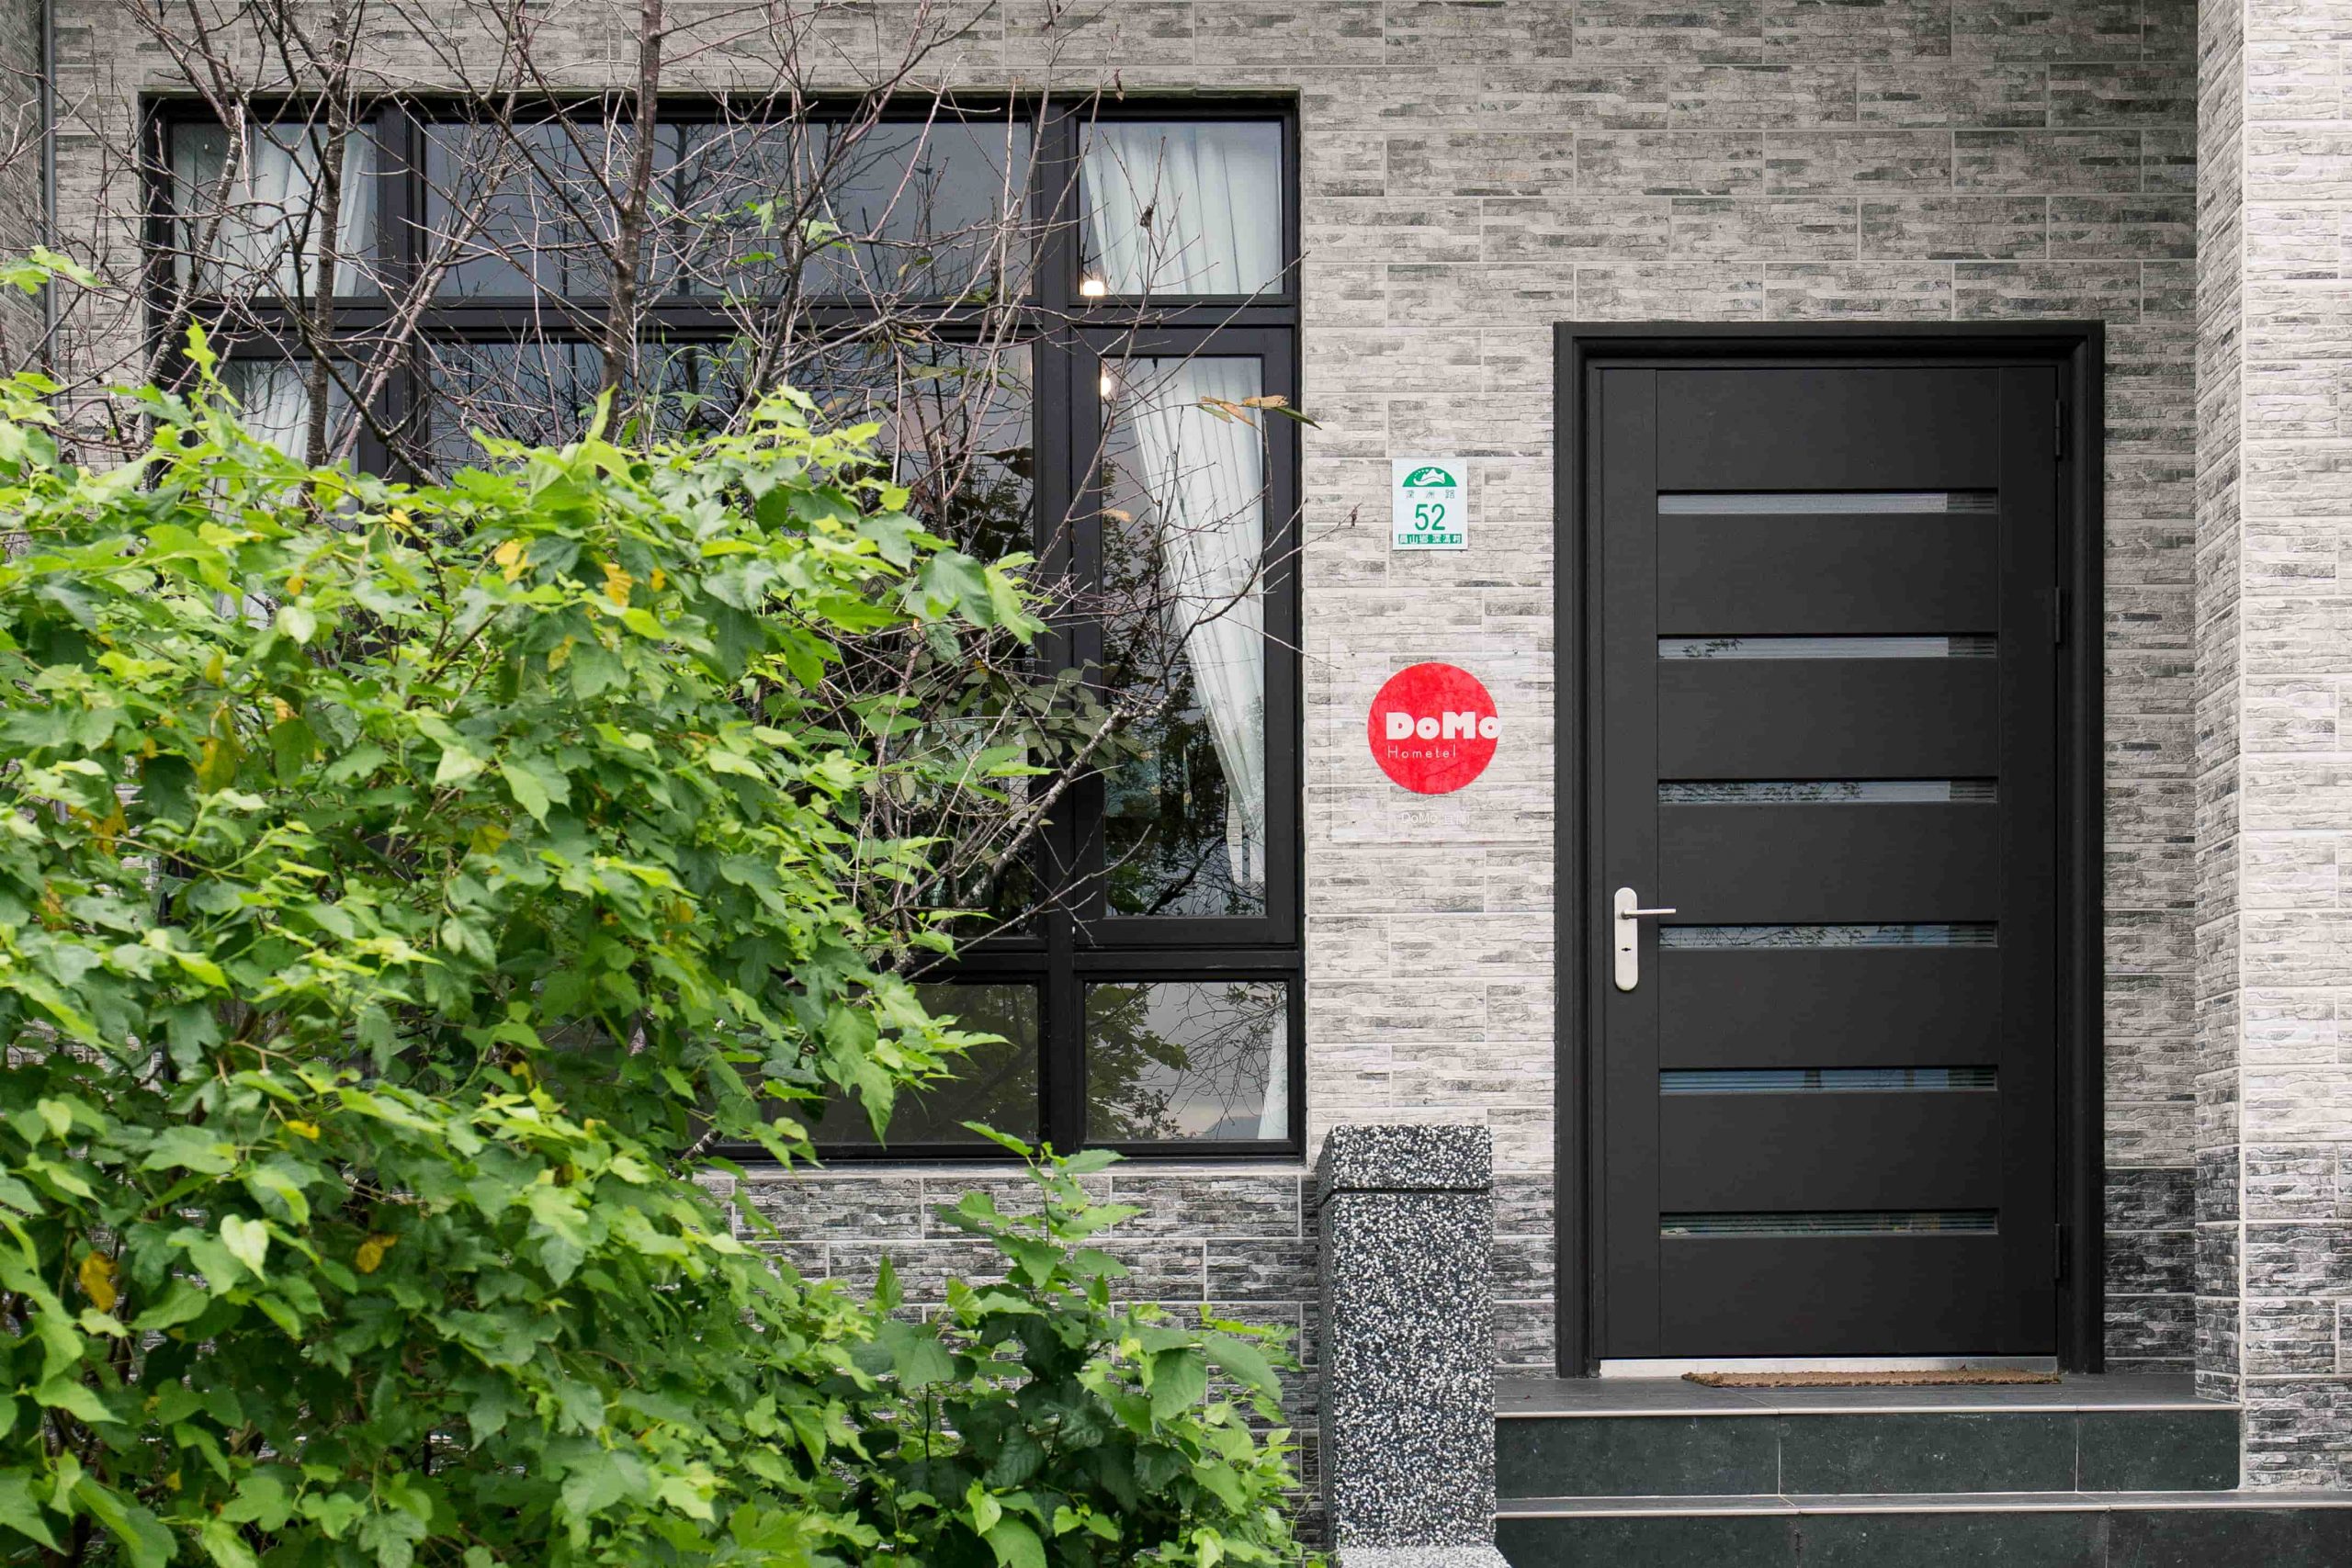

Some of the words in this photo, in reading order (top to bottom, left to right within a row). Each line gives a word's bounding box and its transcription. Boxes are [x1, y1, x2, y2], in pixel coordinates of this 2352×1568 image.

[1415, 503, 1446, 531] 52
[1385, 711, 1502, 740] DoMo
[1387, 744, 1456, 759] Hometel
